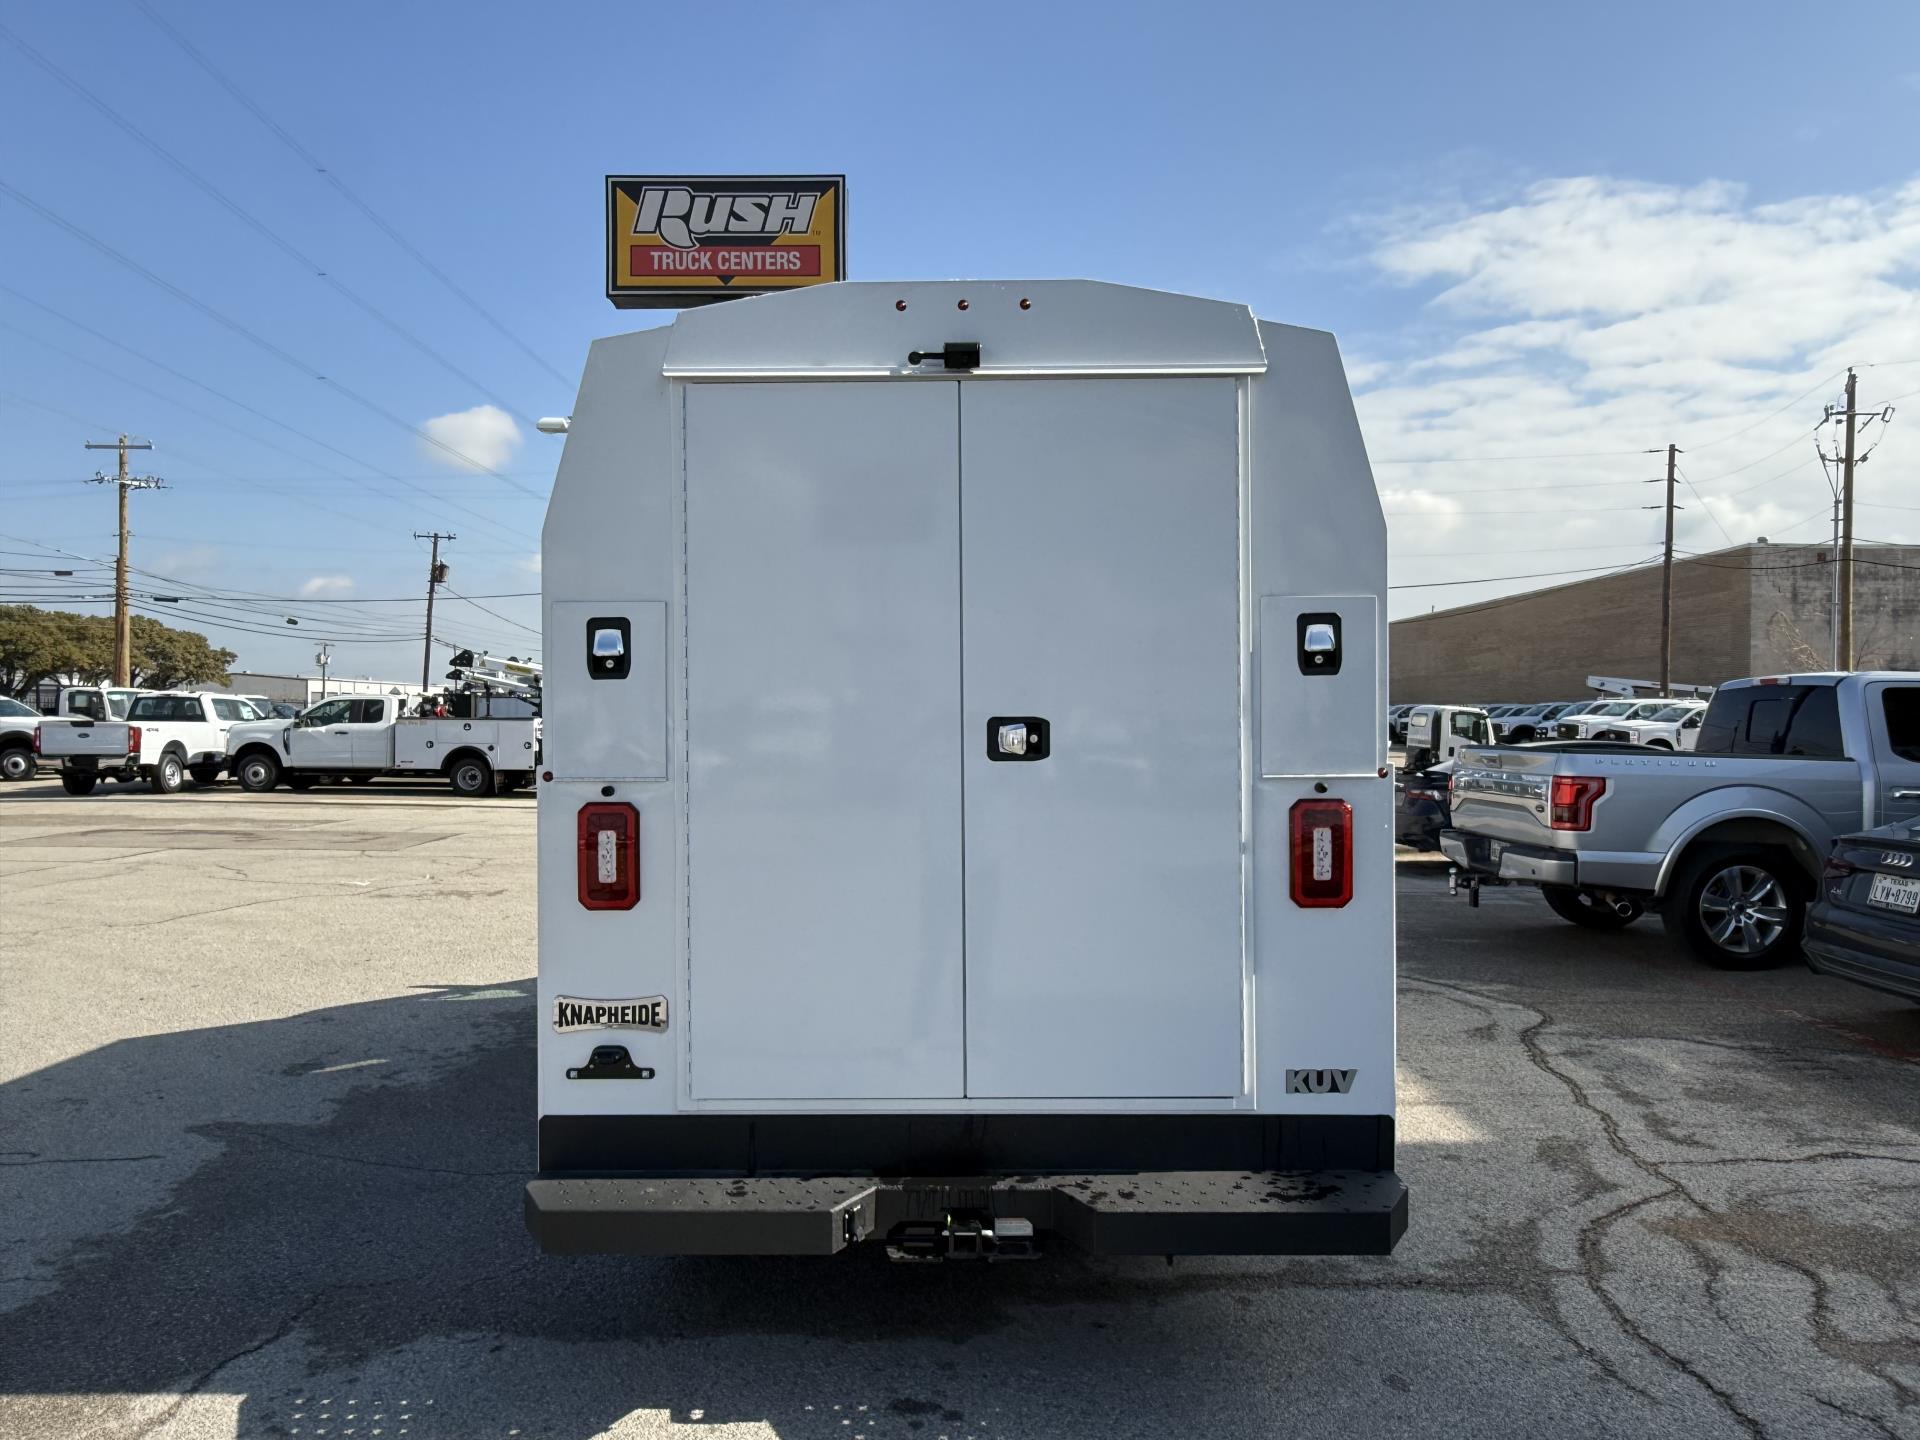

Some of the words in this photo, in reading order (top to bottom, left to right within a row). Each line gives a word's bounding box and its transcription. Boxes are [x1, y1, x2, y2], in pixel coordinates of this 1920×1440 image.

[632, 186, 821, 250] RUSH
[650, 252, 712, 270] TRUCK
[717, 252, 801, 270] CENTERS
[558, 1002, 662, 1028] KNAPHEIDE
[1285, 1068, 1358, 1094] KUV
